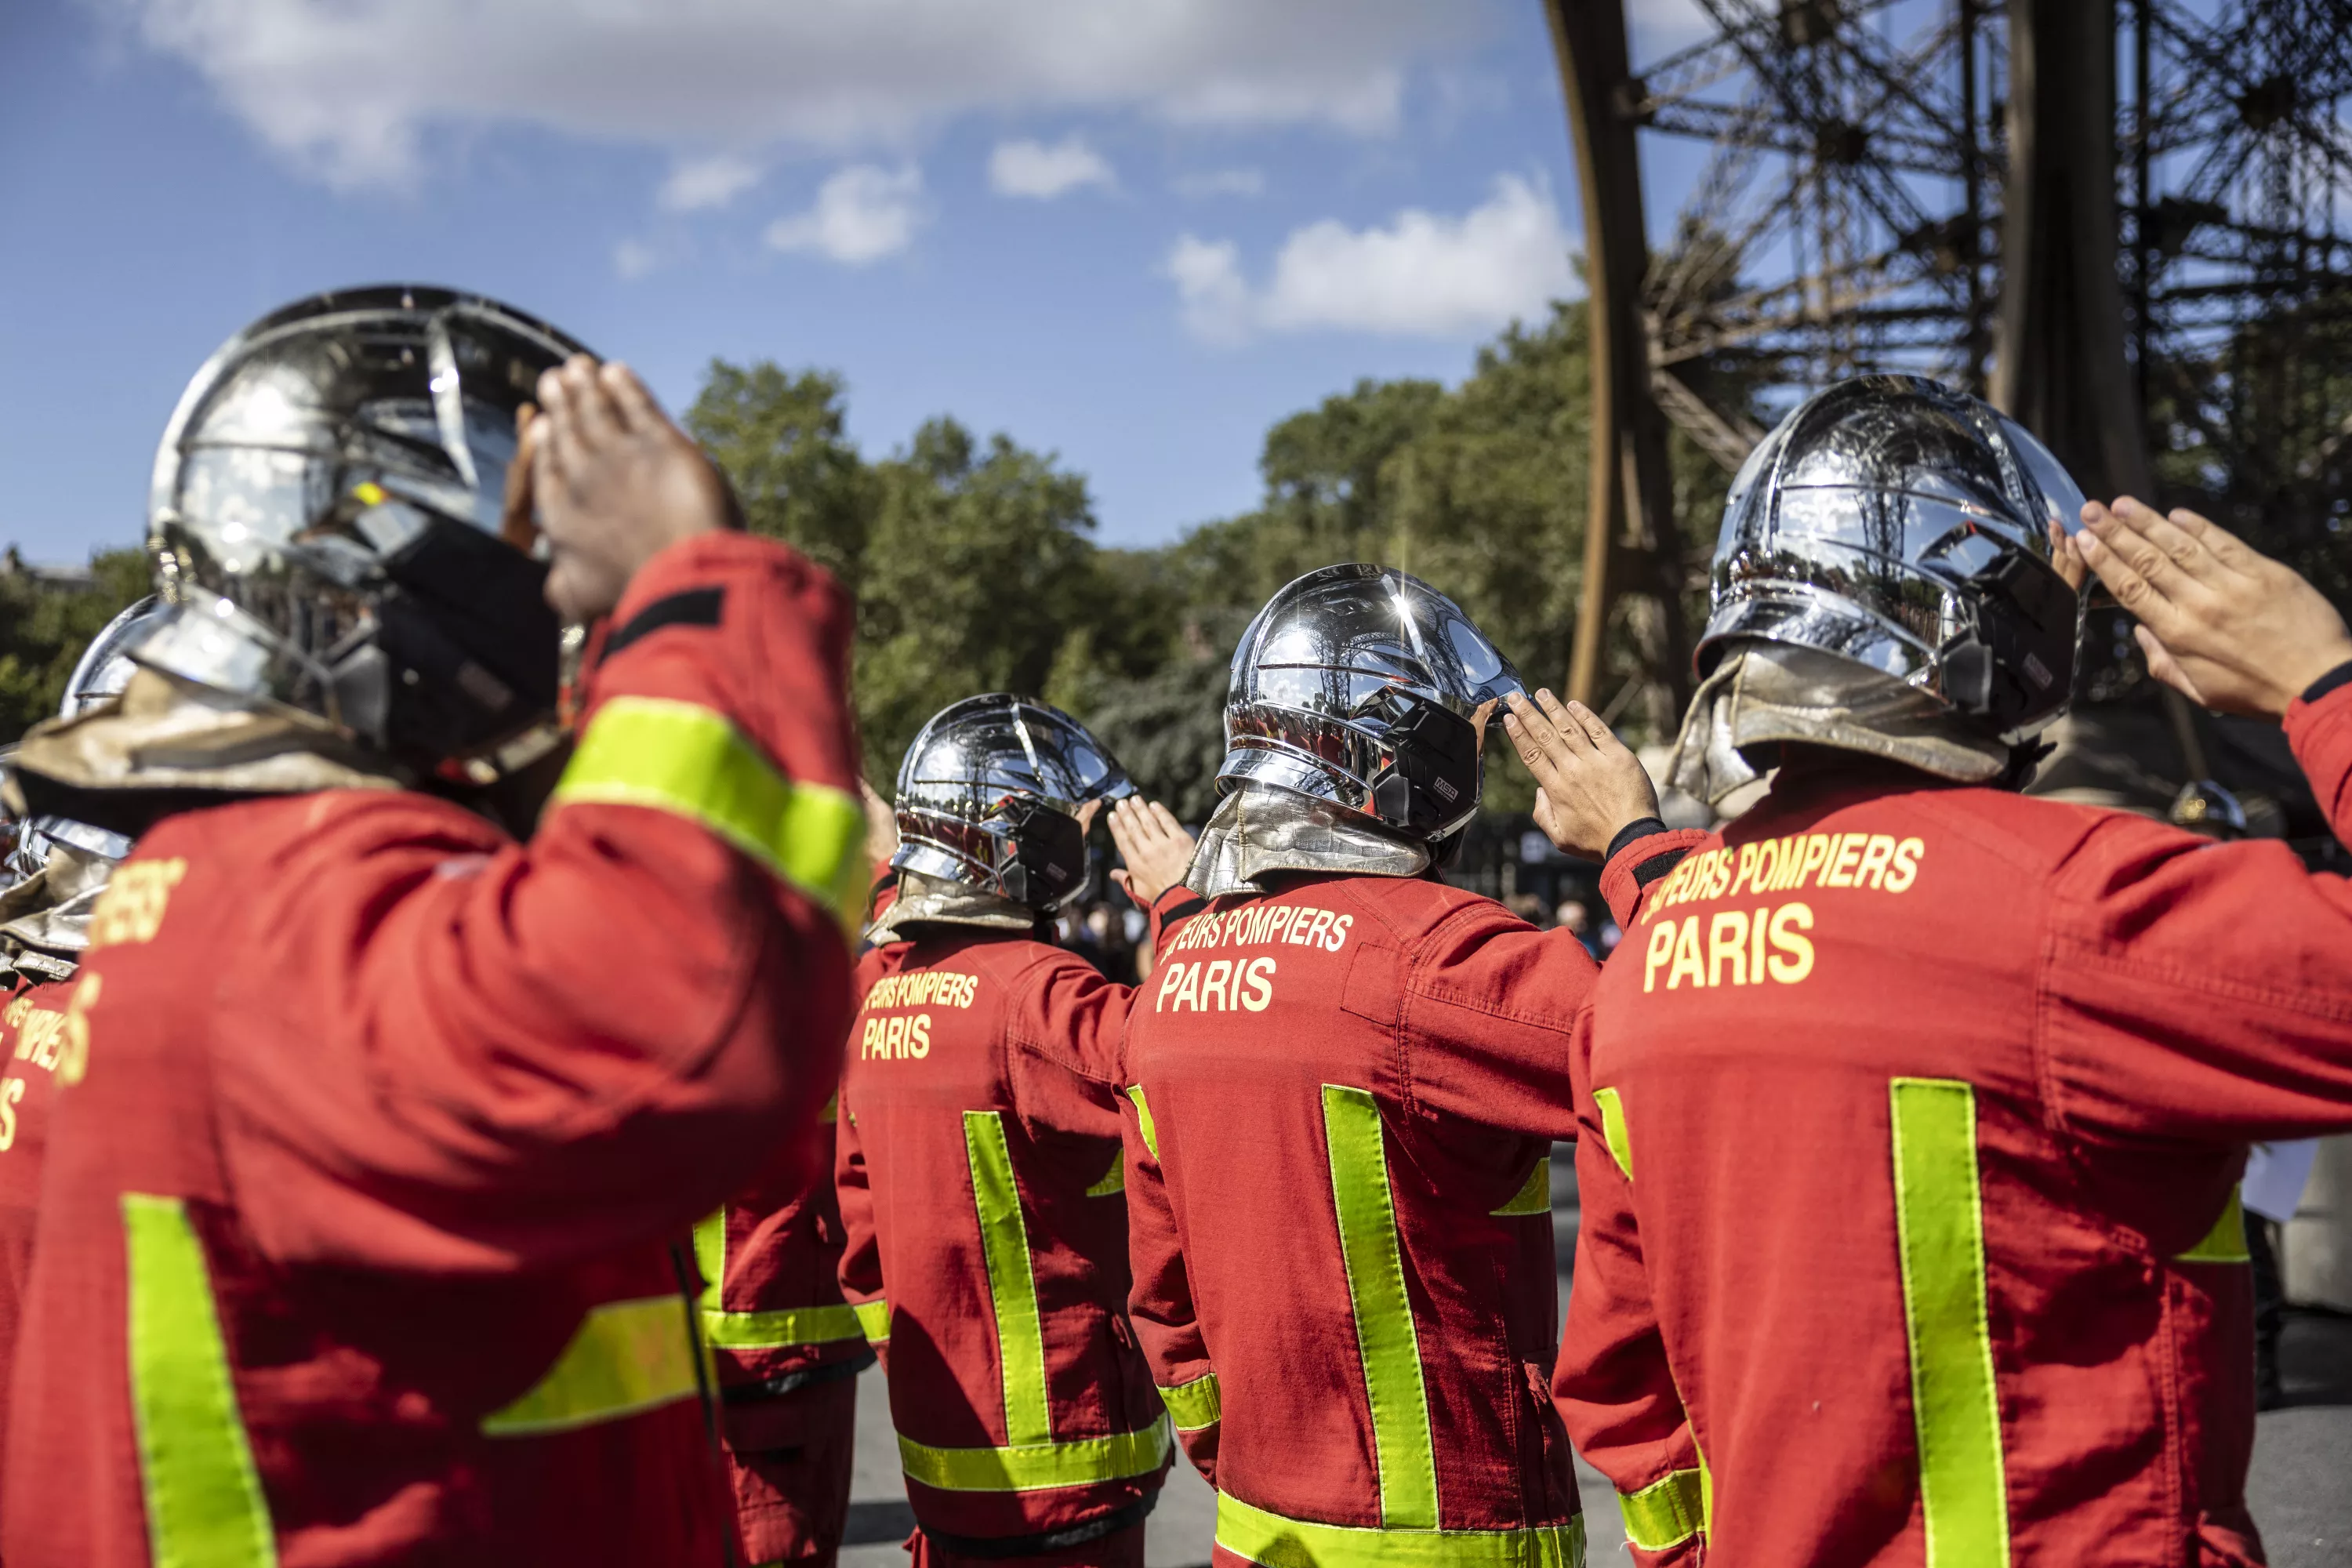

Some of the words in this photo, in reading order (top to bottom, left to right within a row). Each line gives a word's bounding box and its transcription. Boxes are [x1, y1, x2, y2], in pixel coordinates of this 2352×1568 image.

[1436, 779, 1456, 798] MSA
[1730, 833, 1925, 894] POMPIERS
[1221, 906, 1354, 952] POMPIERS
[1643, 902, 1815, 993] PARIS
[895, 971, 978, 1009] POMPIERS
[1156, 956, 1276, 1012] PARIS
[861, 1013, 931, 1061] PARIS
